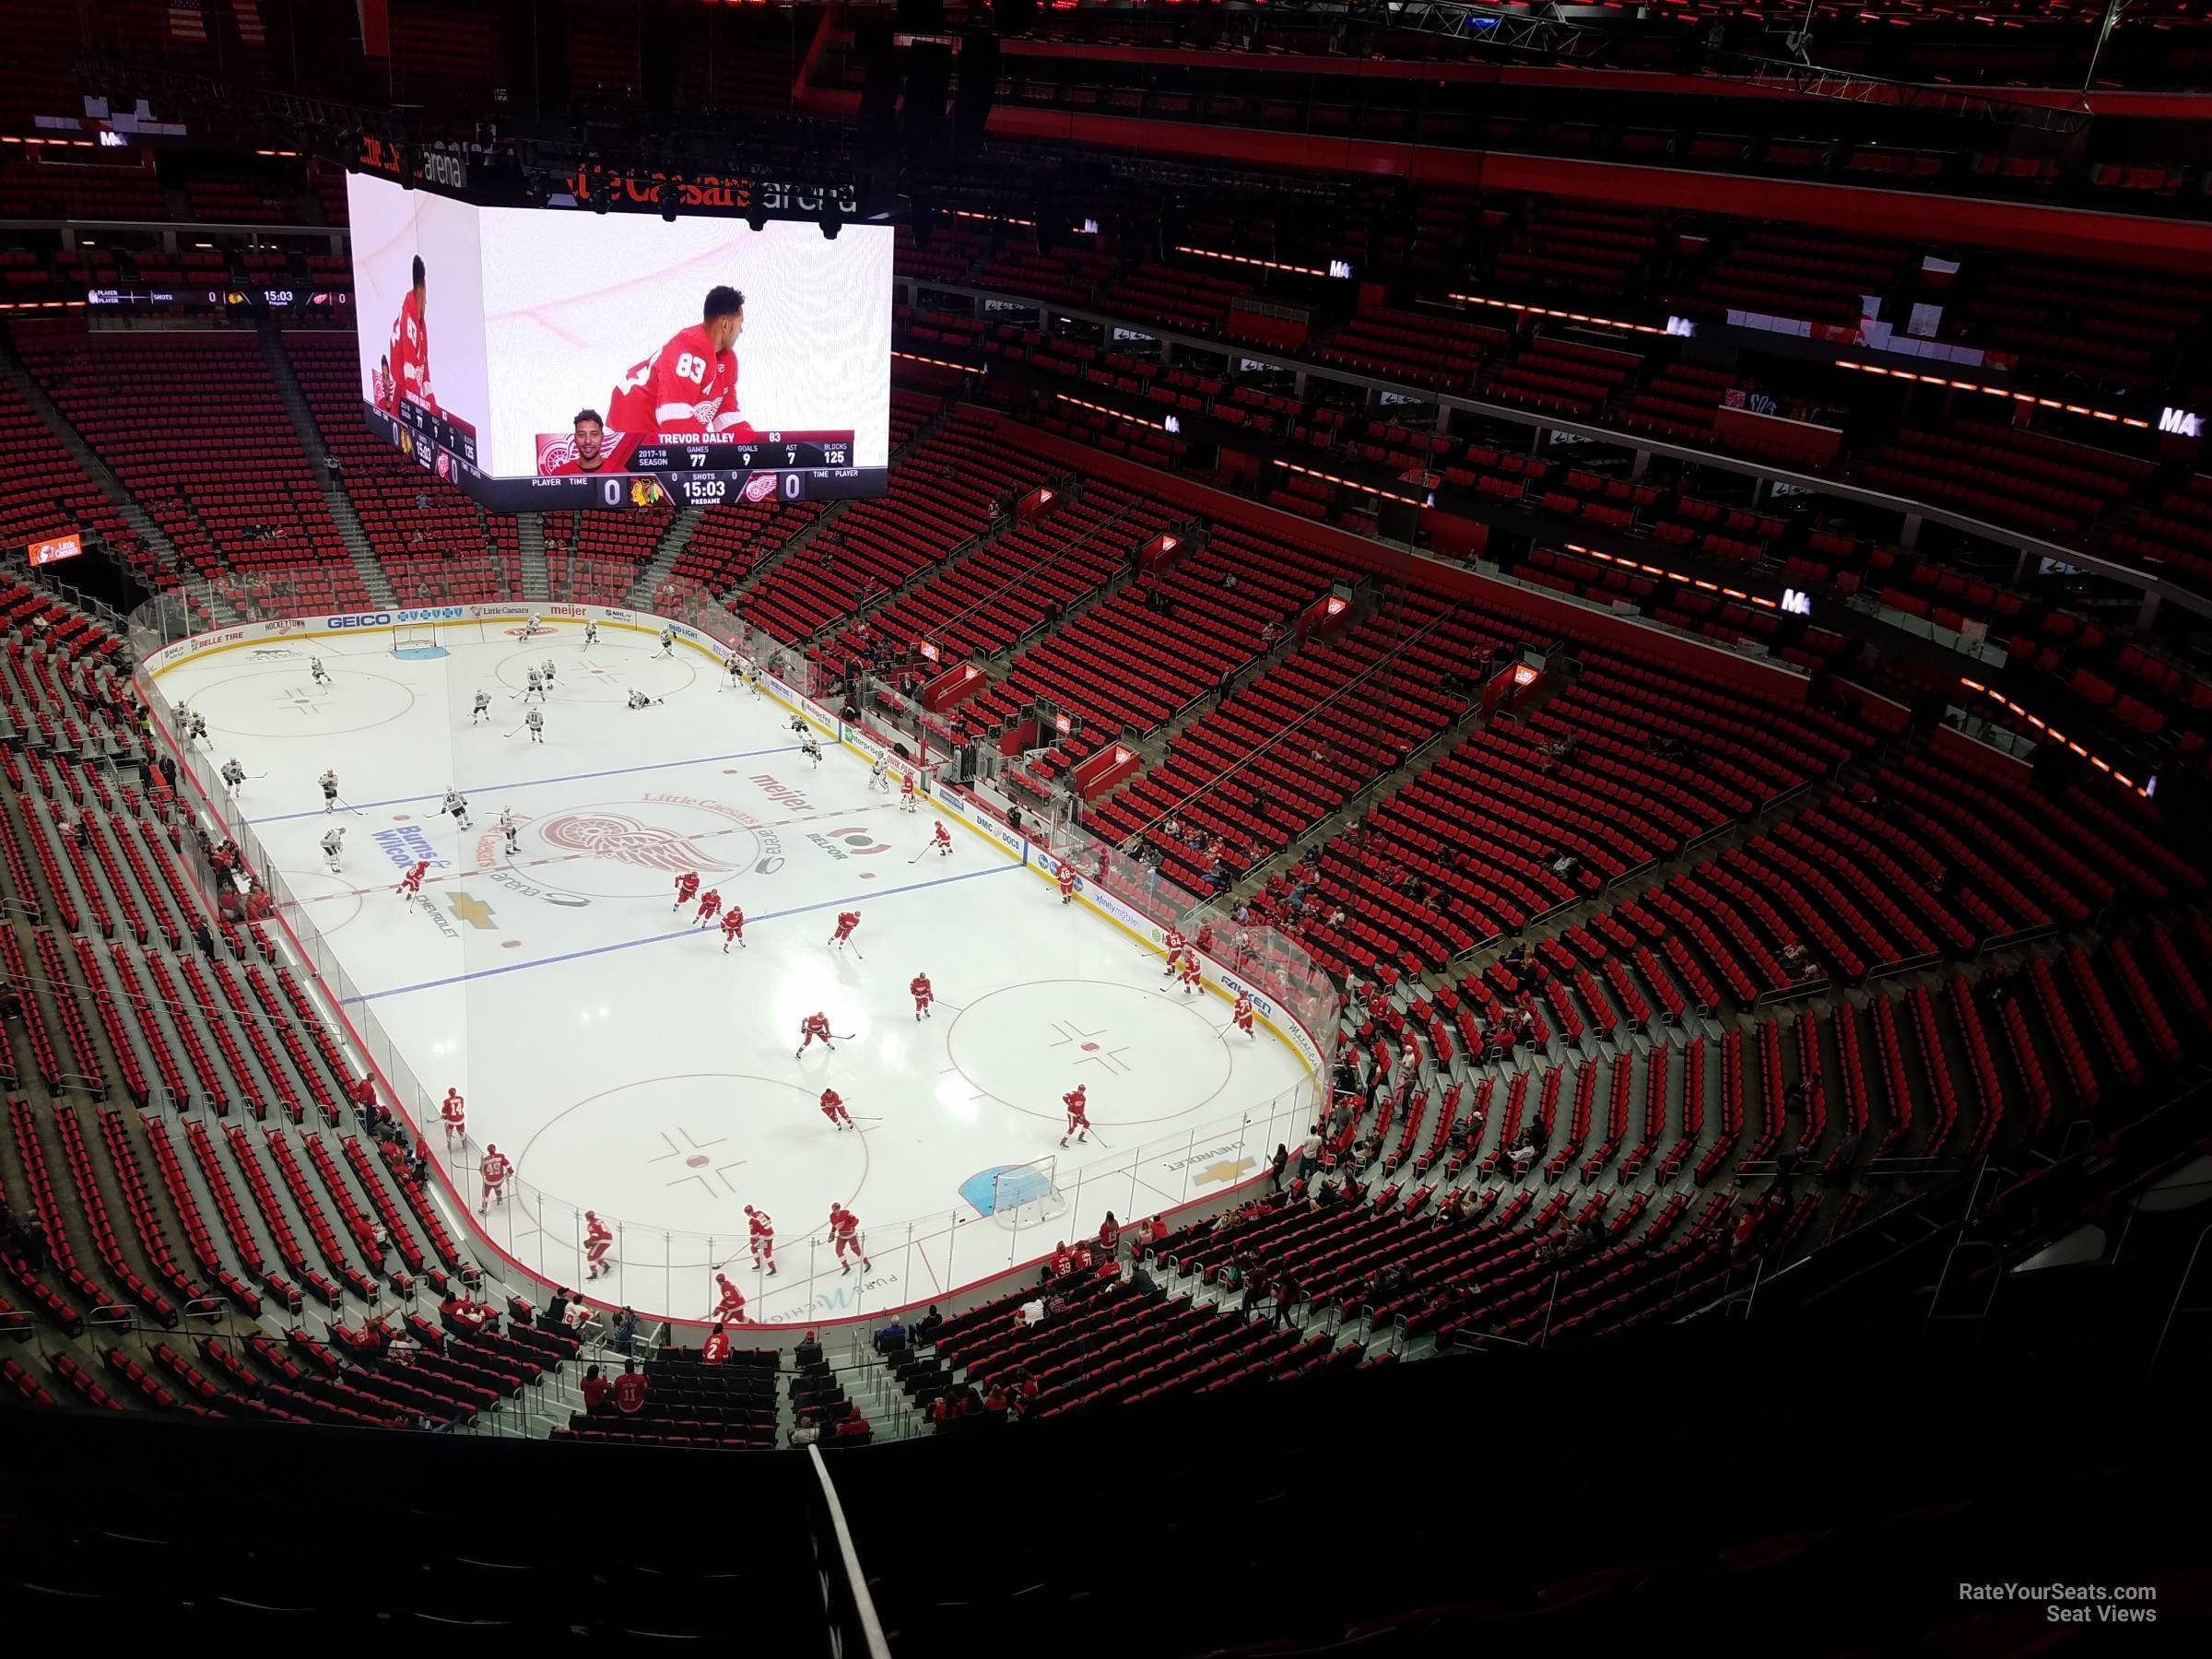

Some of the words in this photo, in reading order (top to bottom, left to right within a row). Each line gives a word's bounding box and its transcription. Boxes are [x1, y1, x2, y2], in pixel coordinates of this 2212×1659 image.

[424, 151, 462, 188] arena
[208, 291, 216, 302] 0
[264, 291, 293, 301] 15:03
[338, 293, 346, 304] 0
[675, 352, 707, 384] 83
[393, 422, 399, 446] 0
[658, 433, 700, 444] TREVOR
[702, 433, 735, 444] DALEY
[769, 431, 781, 442] 83
[416, 441, 432, 463] 15:03
[465, 443, 475, 460] 125
[687, 445, 709, 453] GAMES
[737, 444, 759, 453] GOALS
[824, 442, 848, 451] BLOCKS
[638, 450, 667, 459] 2017-18
[639, 457, 668, 466] SEASON
[689, 453, 706, 467] 77
[743, 453, 751, 466] 9
[787, 452, 795, 465] 7
[824, 451, 845, 464] 125
[451, 459, 459, 484] 0
[672, 472, 678, 482] 0
[692, 472, 716, 481] SHOTS
[731, 471, 738, 480] 0
[813, 470, 830, 478] TIME
[835, 468, 859, 478] PLAYER
[532, 477, 561, 488] PLAYER
[569, 477, 588, 486] TIME
[683, 480, 726, 498] 15:03
[785, 474, 798, 500] 0
[605, 478, 620, 506] 0
[690, 497, 722, 505] PREGAME
[483, 606, 501, 615] Little
[550, 604, 587, 617] meijer
[265, 619, 306, 632] HOCKEYTOWN
[327, 613, 391, 629] GEICO
[668, 623, 682, 634] BUD
[682, 628, 699, 640] LIGHT
[199, 635, 222, 648] BELLE
[224, 631, 244, 642] TIRE
[530, 713, 538, 723] 11
[447, 794, 455, 803] 47
[747, 773, 816, 812] meijer
[641, 792, 698, 806] Little
[698, 799, 760, 826] Caesars
[758, 830, 782, 855] arena
[976, 815, 994, 832] DMC
[1002, 833, 1020, 851] DOCS
[371, 829, 415, 870] Wilcox
[396, 825, 438, 861] Burns
[806, 832, 849, 861] BELFOR
[1060, 870, 1071, 880] 48
[490, 871, 540, 897] arena
[416, 894, 460, 939] CHEVROLET
[450, 1102, 464, 1116] 14
[1167, 1141, 1245, 1172] CHEVROLET
[486, 1161, 501, 1176] 49
[1059, 1262, 1072, 1276] 39
[1083, 1257, 1092, 1267] 71
[853, 1274, 898, 1295] PURE
[762, 1277, 858, 1324] MICHIG
[707, 1344, 717, 1359] 2
[623, 1388, 636, 1402] 11
